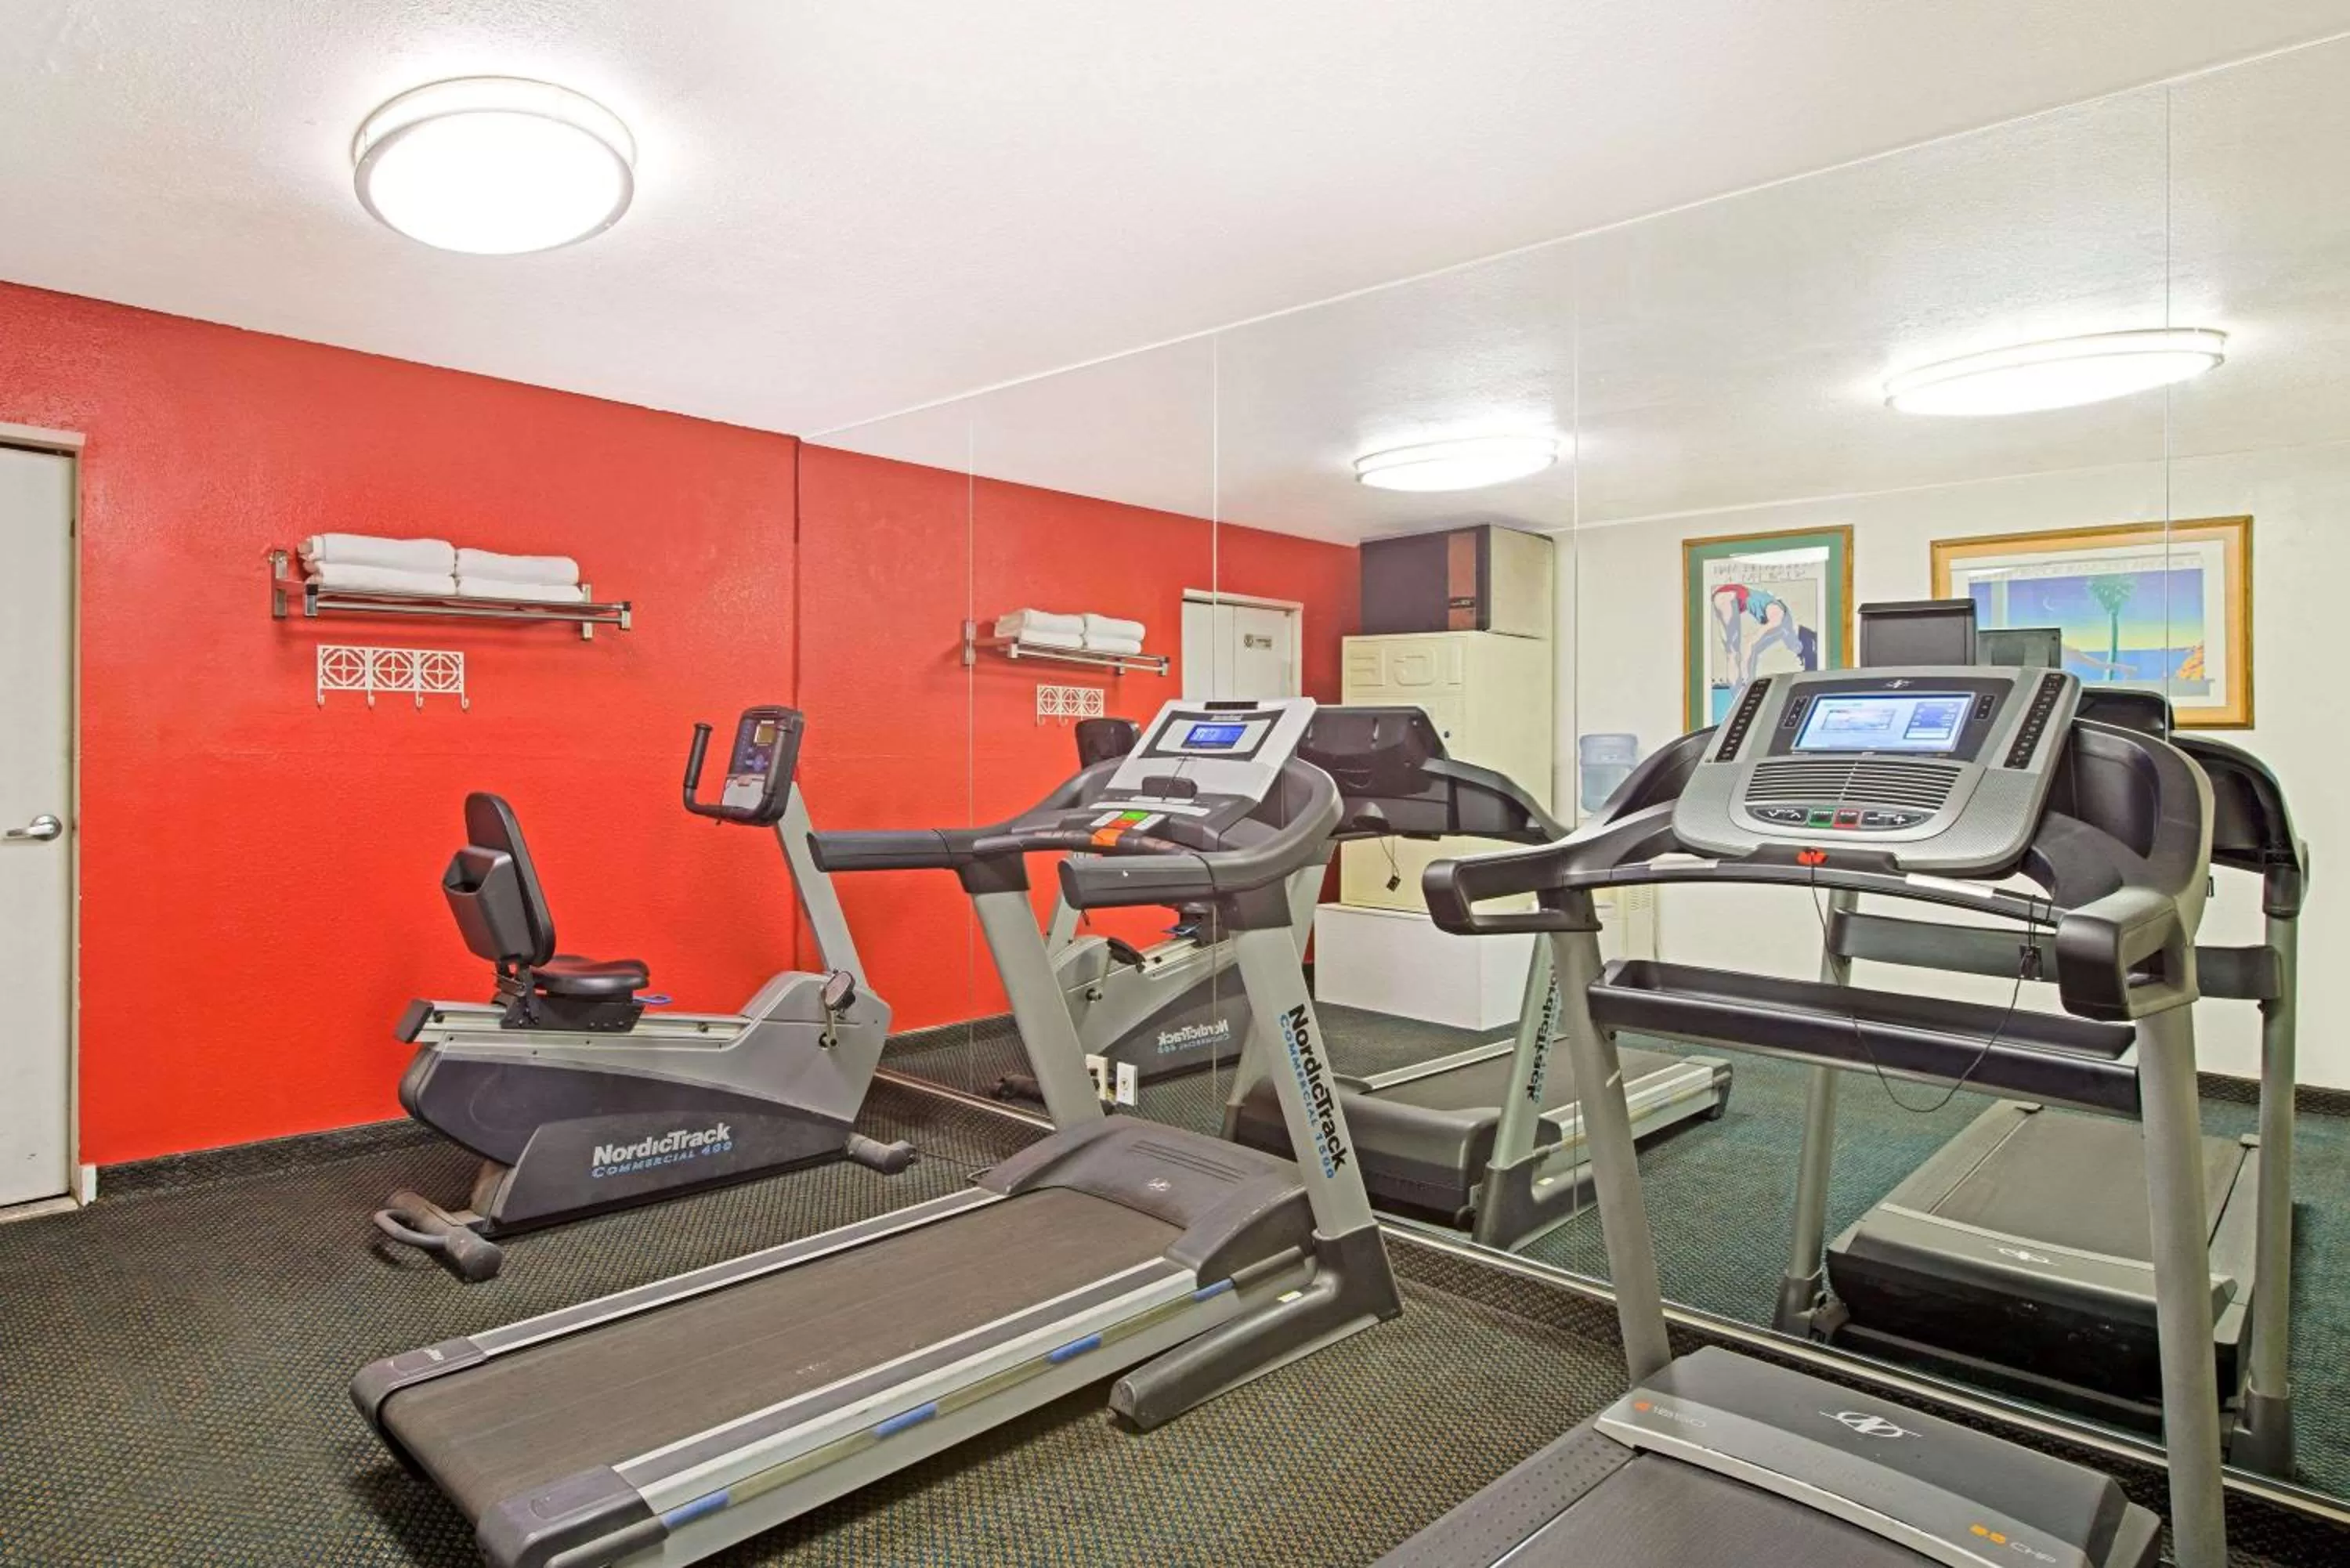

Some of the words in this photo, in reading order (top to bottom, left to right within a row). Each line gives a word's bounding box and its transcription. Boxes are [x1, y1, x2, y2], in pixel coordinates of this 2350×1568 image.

[1279, 1014, 1318, 1128] COMMERCIAL
[1288, 1003, 1348, 1173] NordicTrack
[591, 1122, 732, 1167] NordicTrack
[591, 1151, 696, 1179] COMMERCIAL
